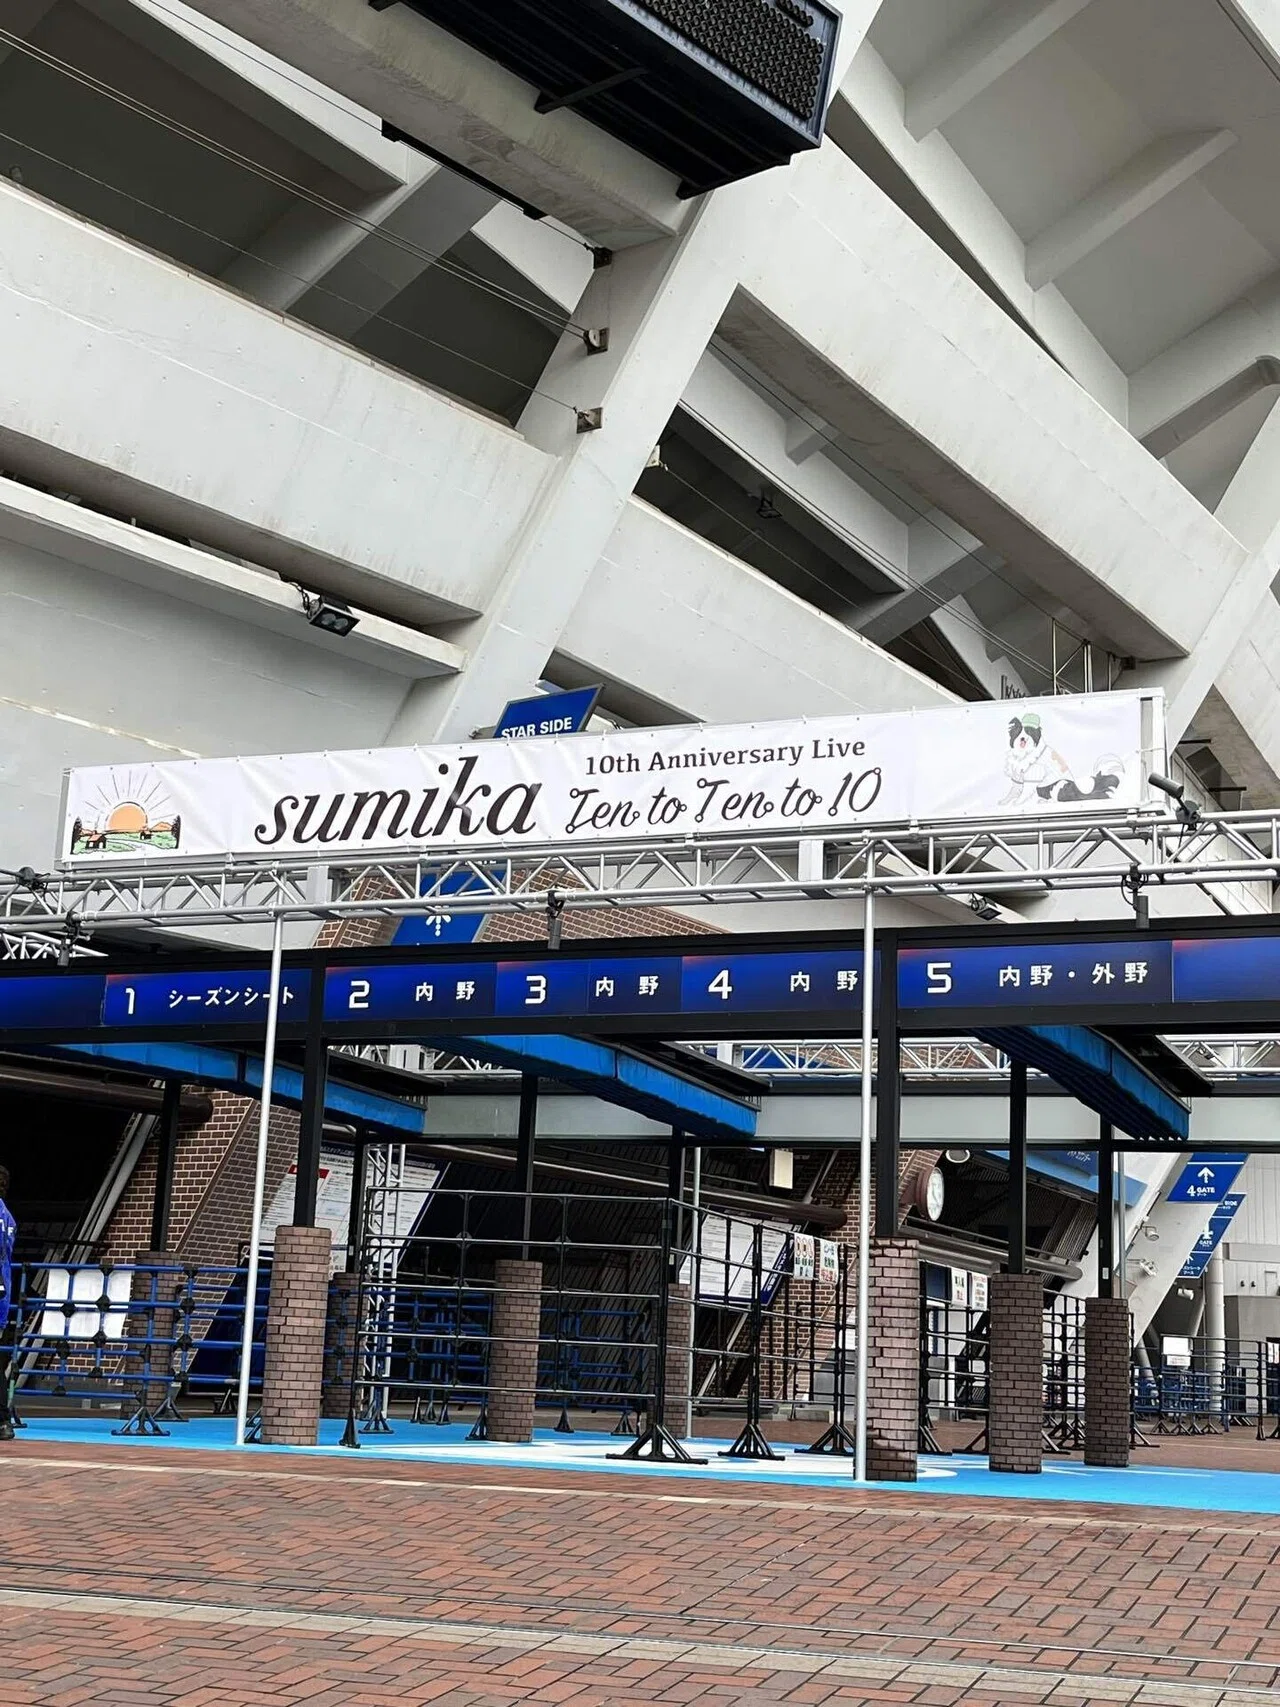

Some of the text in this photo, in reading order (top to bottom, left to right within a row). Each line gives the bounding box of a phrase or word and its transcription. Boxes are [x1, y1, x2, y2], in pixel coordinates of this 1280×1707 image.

[501, 717, 573, 739] STAR SIDE
[585, 738, 866, 775] 10th Anniversary Live
[254, 755, 543, 845] sumika
[565, 767, 882, 834] Ten to Ten to 10
[524, 975, 660, 1005] 3 内野
[708, 969, 859, 1000] 4 内野
[927, 960, 1149, 994] 5 内野・外野
[125, 985, 295, 1015] 1 シーズンシート
[348, 980, 476, 1009] 2 内野
[1187, 1185, 1196, 1197] 4
